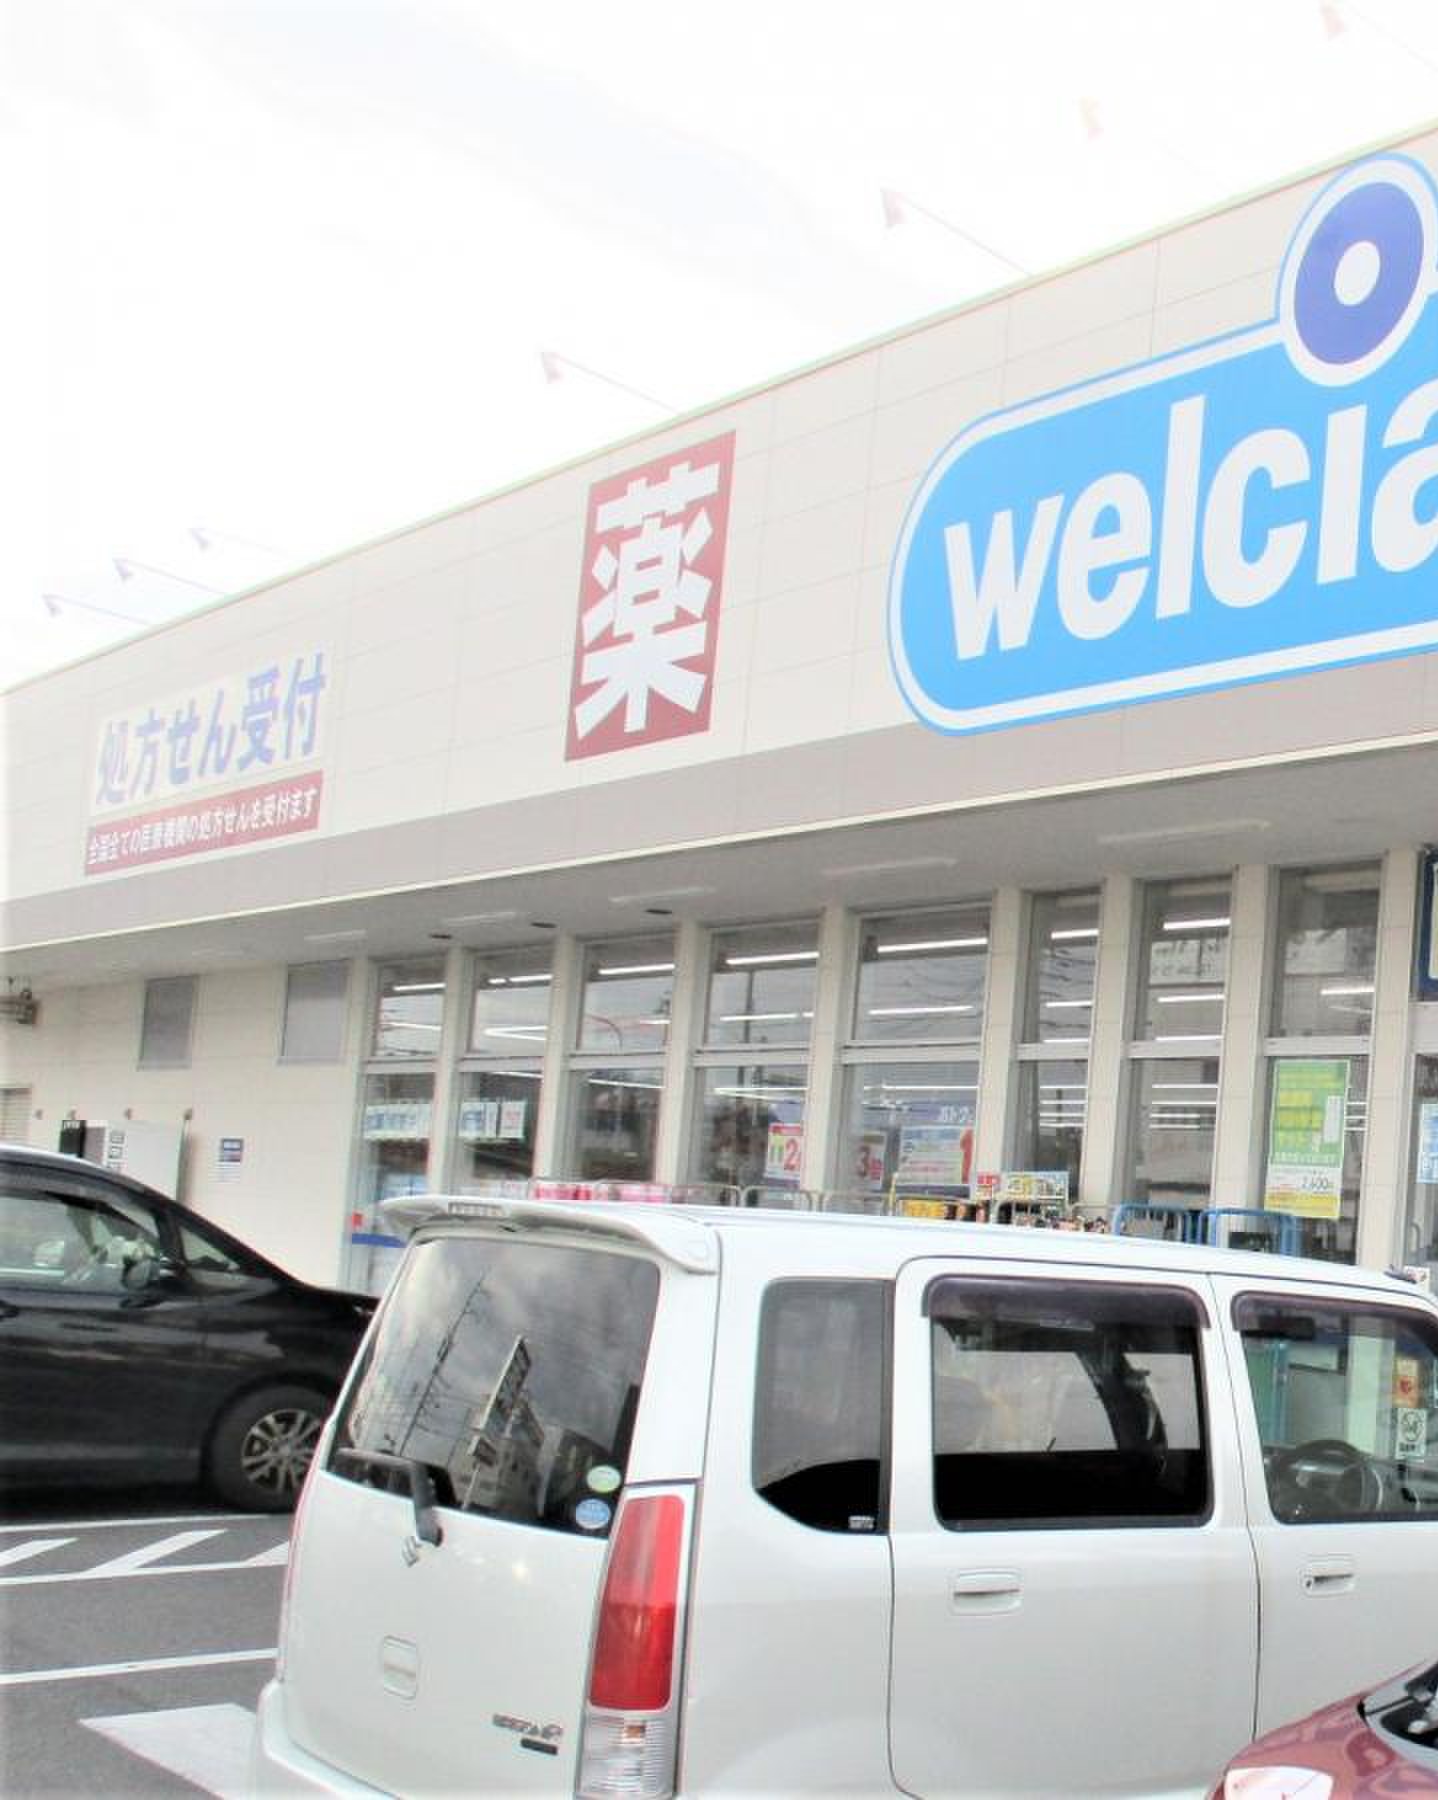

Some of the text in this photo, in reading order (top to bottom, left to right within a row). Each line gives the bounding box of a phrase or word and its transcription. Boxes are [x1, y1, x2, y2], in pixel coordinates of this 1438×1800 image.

[574, 459, 721, 738] 薬
[96, 652, 326, 804] 処方せん受付
